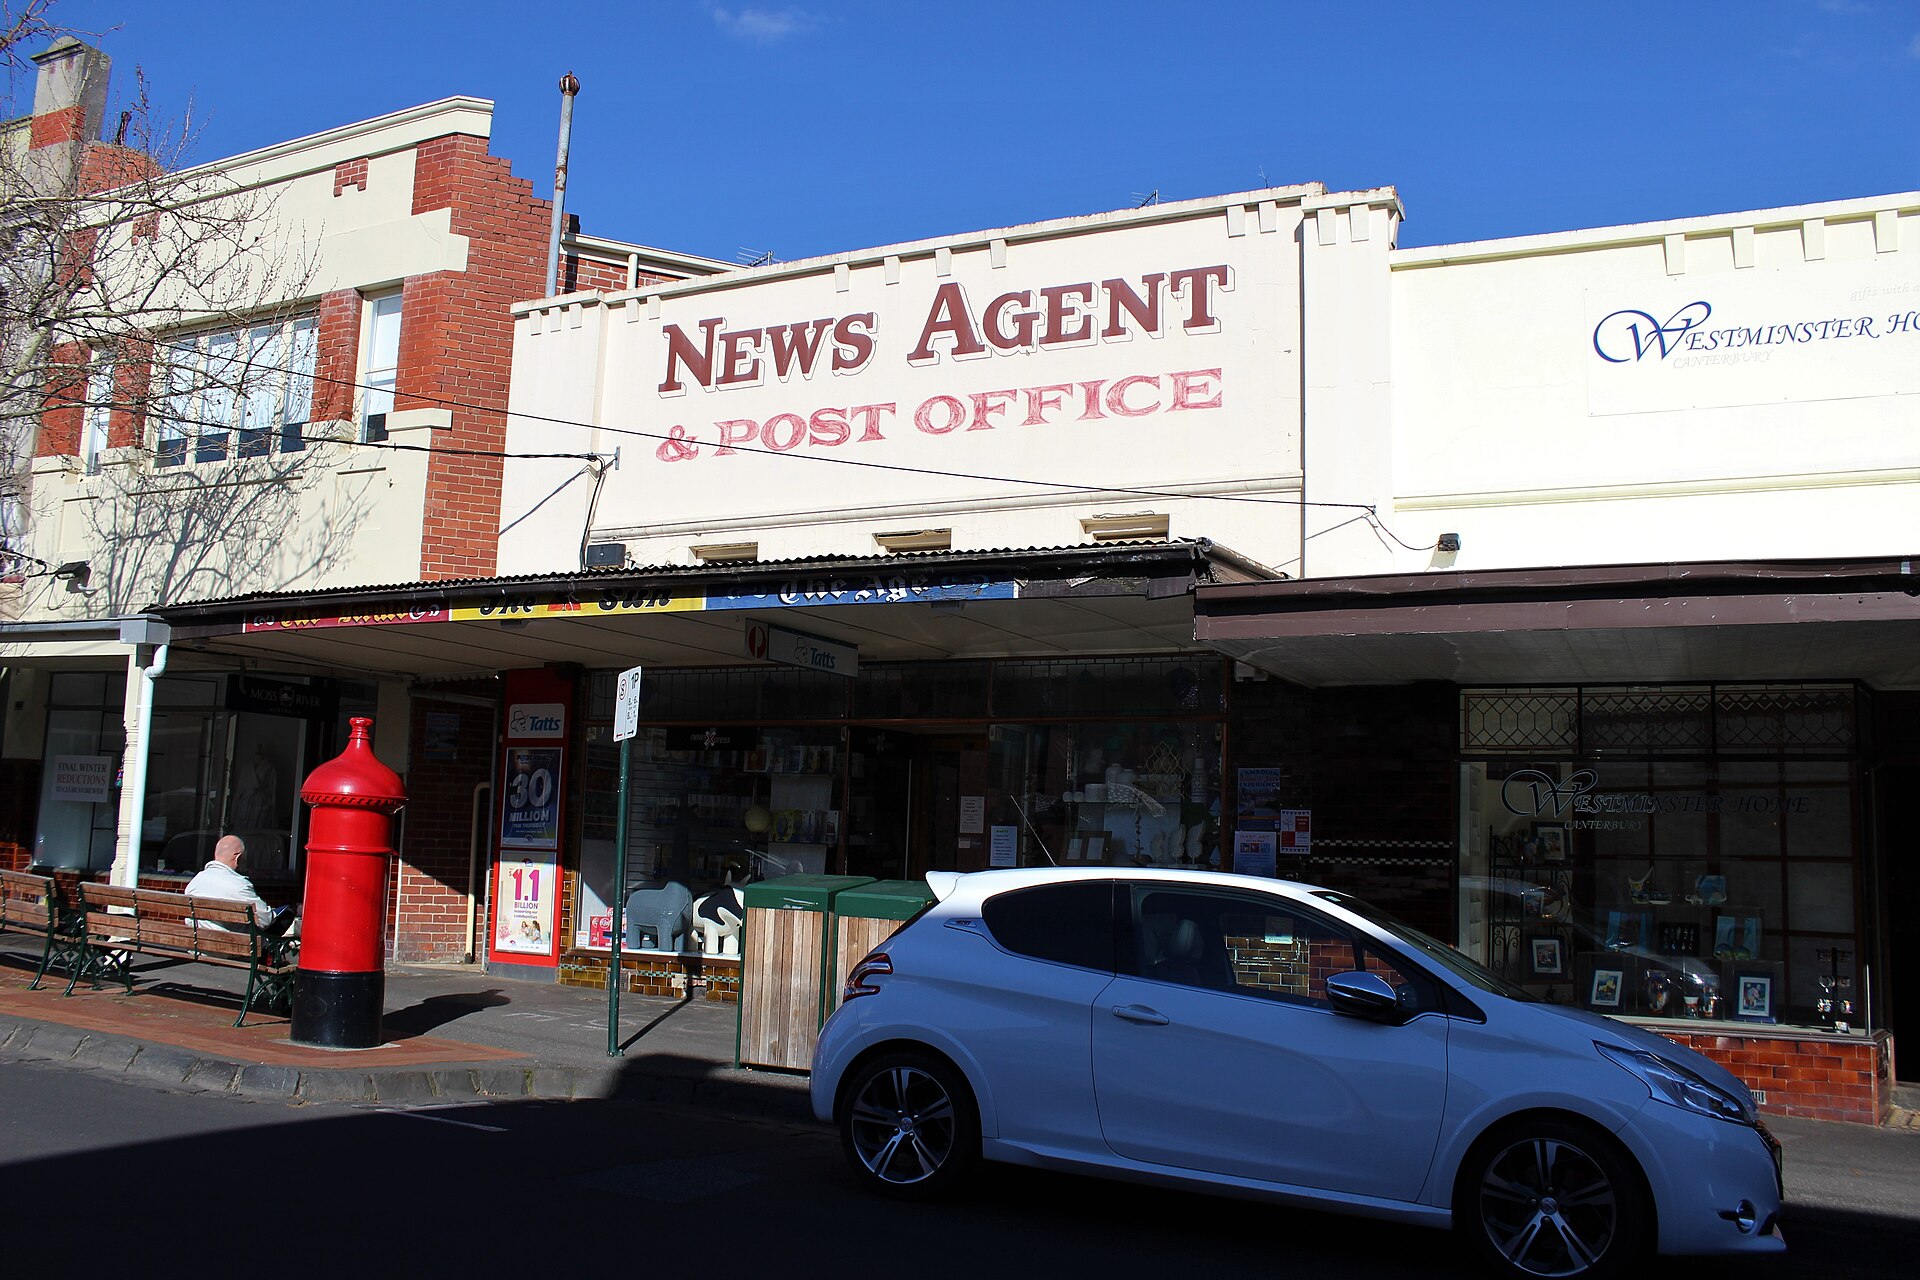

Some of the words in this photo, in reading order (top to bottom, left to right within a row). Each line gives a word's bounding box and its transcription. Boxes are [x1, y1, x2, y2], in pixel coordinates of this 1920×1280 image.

[1593, 301, 1880, 363] WESTMINSTER
[1673, 350, 1774, 369] CANTERBURY
[656, 424, 699, 462] &
[711, 402, 896, 457] POST
[914, 367, 1223, 435] OFFICE
[599, 587, 673, 610] Sun
[810, 647, 836, 669] Tatts
[250, 688, 277, 702] MOSS
[296, 695, 321, 707] RIVER
[529, 716, 560, 731] Tatts
[58, 762, 76, 772] FINAL
[79, 763, 106, 773] WINTER
[56, 773, 106, 785] REDUCTIONS
[1501, 768, 1728, 818] WESTMINSTER
[1733, 796, 1810, 813] HOME
[509, 811, 550, 823] MILLION
[1564, 820, 1644, 832] CANTERBURY
[514, 901, 539, 910] BILLION
